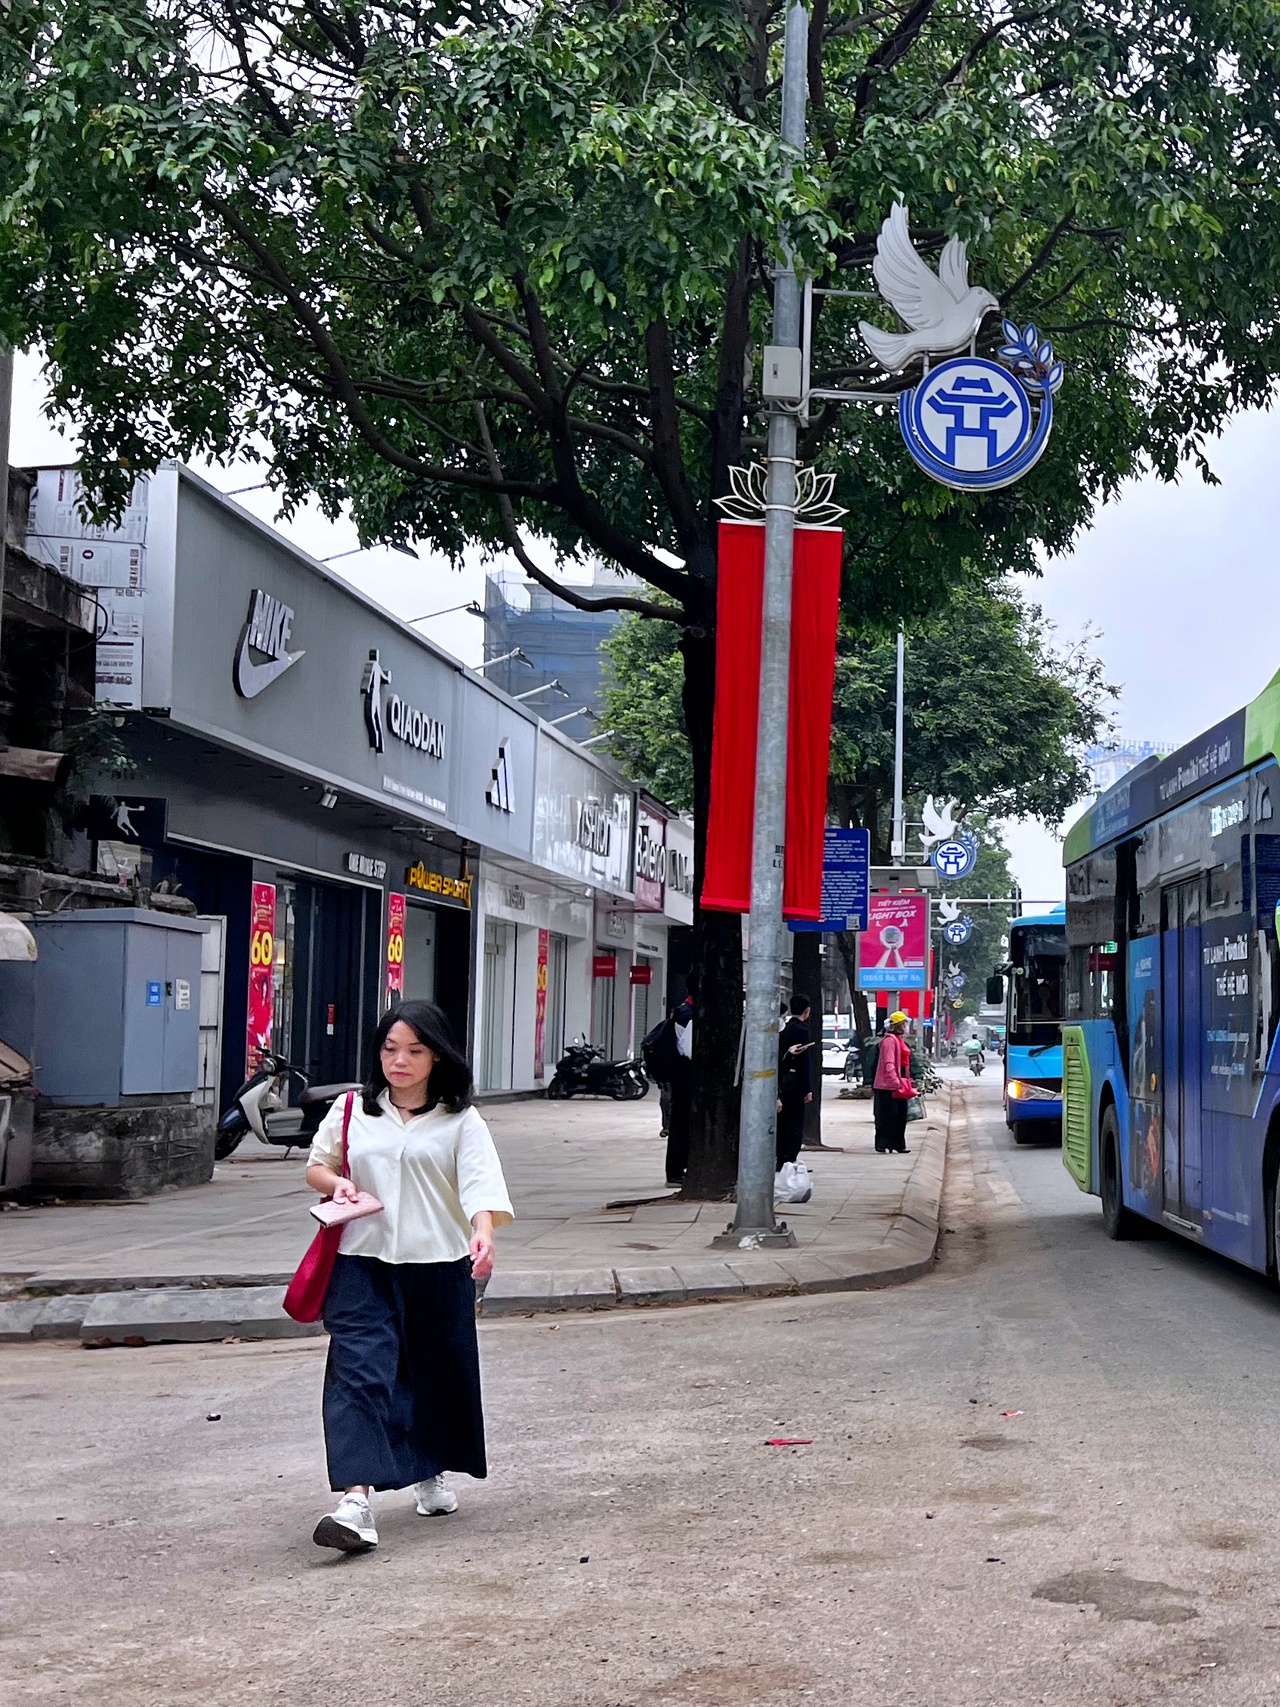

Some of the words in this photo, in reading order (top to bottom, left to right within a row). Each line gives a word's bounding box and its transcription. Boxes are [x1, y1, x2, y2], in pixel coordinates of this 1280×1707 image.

[248, 589, 295, 660] NIKE
[389, 693, 446, 760] QIAODAN
[869, 911, 896, 920] LIGHT
[895, 910, 917, 919] BOX
[251, 930, 273, 966] 60
[388, 934, 403, 963] 60
